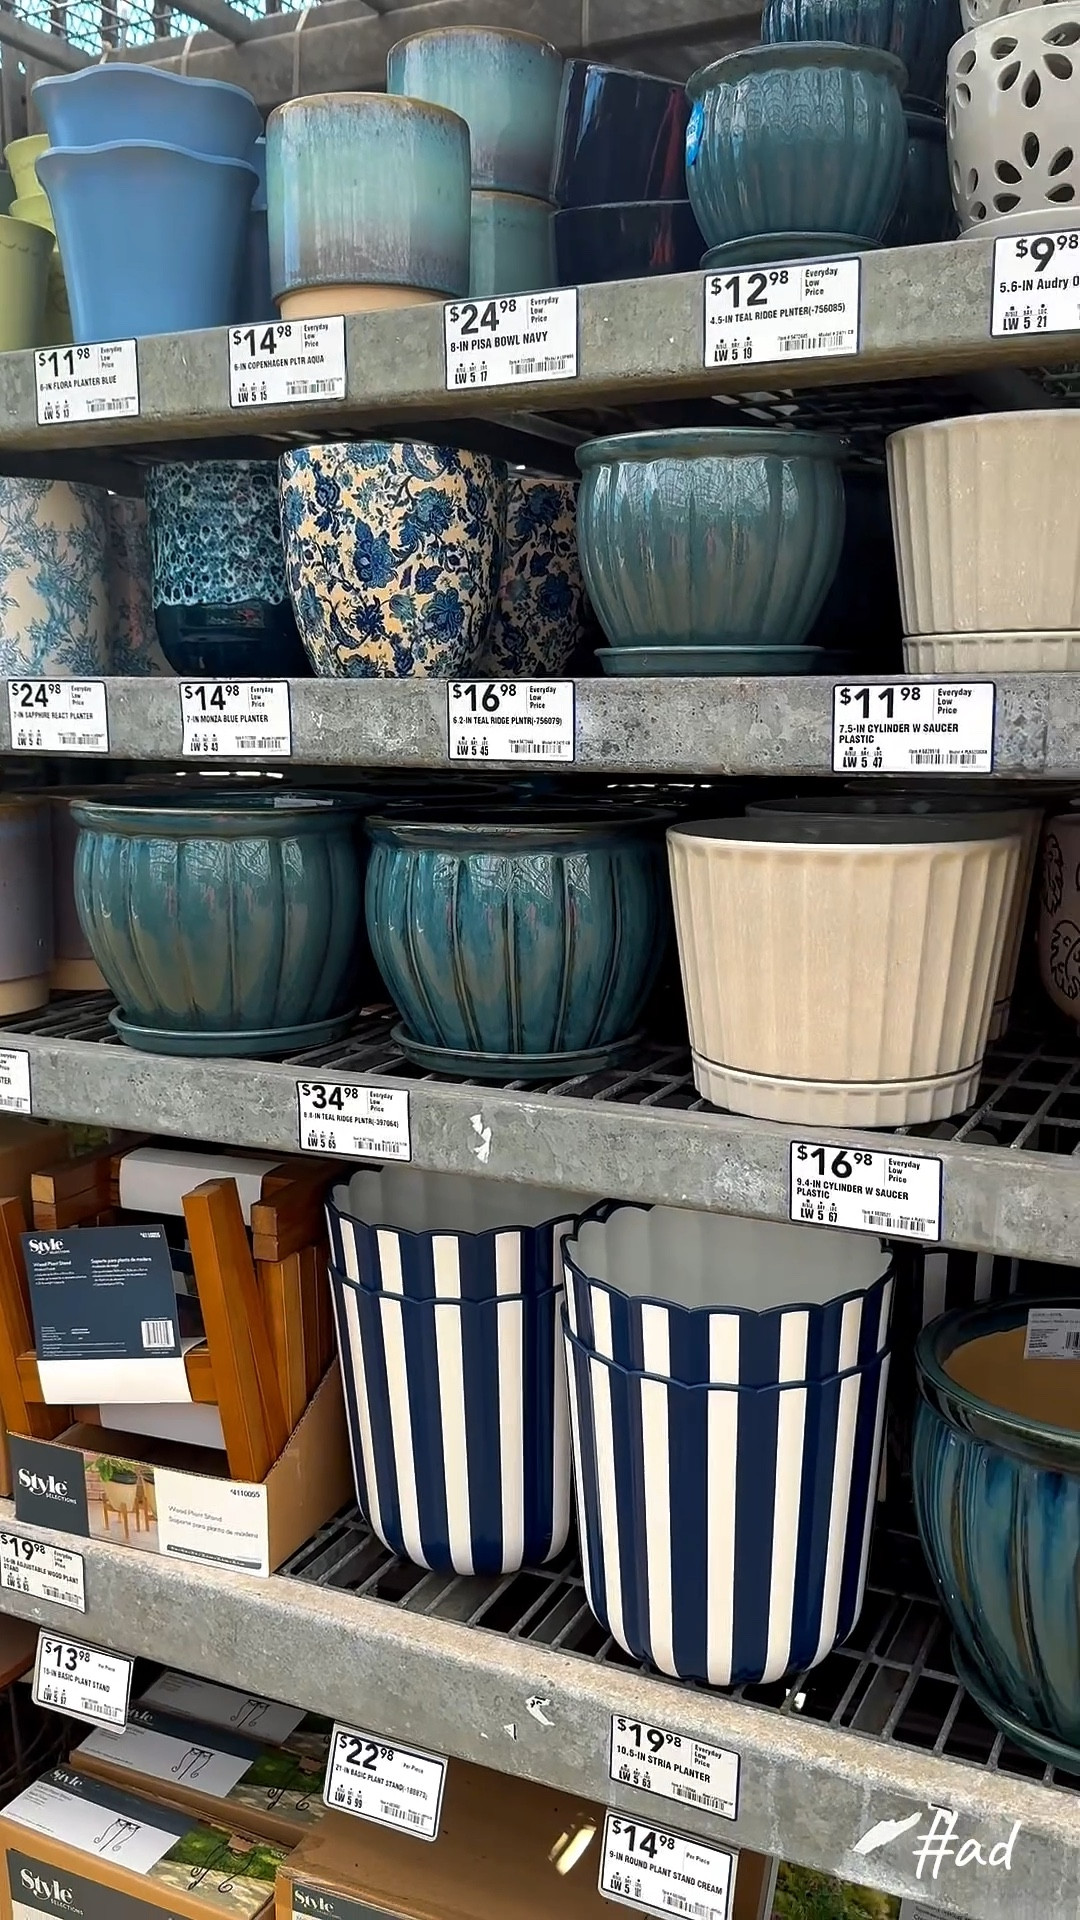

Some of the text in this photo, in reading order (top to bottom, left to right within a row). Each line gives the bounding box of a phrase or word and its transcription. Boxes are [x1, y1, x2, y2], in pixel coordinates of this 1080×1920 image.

[805, 267, 838, 278] Everyday
[805, 279, 819, 287] Low
[1000, 276, 1069, 293] 5.6-IN Audry
[805, 288, 824, 296] Price
[530, 296, 559, 306] Everyday
[710, 315, 733, 325] 4.5-IN
[735, 312, 753, 322] TEAL
[755, 309, 778, 320] RIDGE
[1003, 315, 1047, 330] LW 5 21
[303, 324, 328, 332] Everyday
[450, 331, 548, 352] 8-IN PISA BOWL NAVY
[714, 347, 752, 362] LW 5 19
[234, 355, 324, 371] 6-IN COPENHAGEN PLTR AQUA
[53, 381, 72, 390] FLORA
[73, 378, 100, 387] PLANTER
[101, 375, 117, 384] BLUE
[455, 371, 487, 384] LW 5 17
[238, 390, 267, 403] LW 5 15
[56, 411, 60, 419] 5
[529, 686, 557, 694] Everyday
[937, 688, 972, 697] Everyday
[25, 711, 50, 719] SAPPHIRE
[70, 712, 93, 720] PLANTER
[200, 715, 222, 723] MONZA
[223, 715, 238, 723] BLUE
[240, 714, 269, 723] PLANTER
[473, 716, 489, 724] TEAL
[490, 717, 509, 725] RIDGE
[839, 723, 959, 733] 7.5-IN CYLINDER W SAUCER
[839, 735, 875, 743] PLASTIC
[203, 742, 208, 751] 5
[457, 746, 489, 756] LW 5 45
[843, 756, 883, 768] LW 5 47
[322, 1113, 335, 1121] TEAL
[336, 1115, 352, 1123] RIDGE
[308, 1137, 336, 1149] LW 5 65
[888, 1158, 920, 1170] Everyday
[888, 1167, 903, 1175] Low
[888, 1175, 907, 1184] Price
[797, 1178, 909, 1200] 9.4-IN CYLINDER W SAUCER
[797, 1187, 830, 1199] PLASTIC
[800, 1208, 838, 1223] LW 5 67
[28, 1238, 64, 1256] Style
[18, 1468, 68, 1496] Style
[45, 1493, 77, 1505] SELECTIONS
[16, 1560, 46, 1575] ADJUSTABLE
[47, 1570, 62, 1579] WOOD
[58, 1671, 74, 1682] BASIC
[74, 1676, 92, 1688] PLANT
[92, 1681, 110, 1692] STAND
[694, 1744, 722, 1759] Everyday
[617, 1745, 711, 1783] 10.5-IN STRIA PLANTER
[694, 1759, 710, 1768] Price
[51, 1769, 84, 1789] Style
[351, 1768, 366, 1780] BASIC
[367, 1774, 384, 1785] PLANT
[619, 1770, 651, 1789] LW 5 63
[334, 1792, 345, 1802] LW
[347, 1796, 352, 1806] 5
[609, 1850, 723, 1895] 9-IN ROUND PLANT STAND CREAM
[19, 1867, 73, 1904] Style
[610, 1879, 622, 1891] LW
[624, 1883, 630, 1894] 5
[294, 1889, 334, 1912] Style
